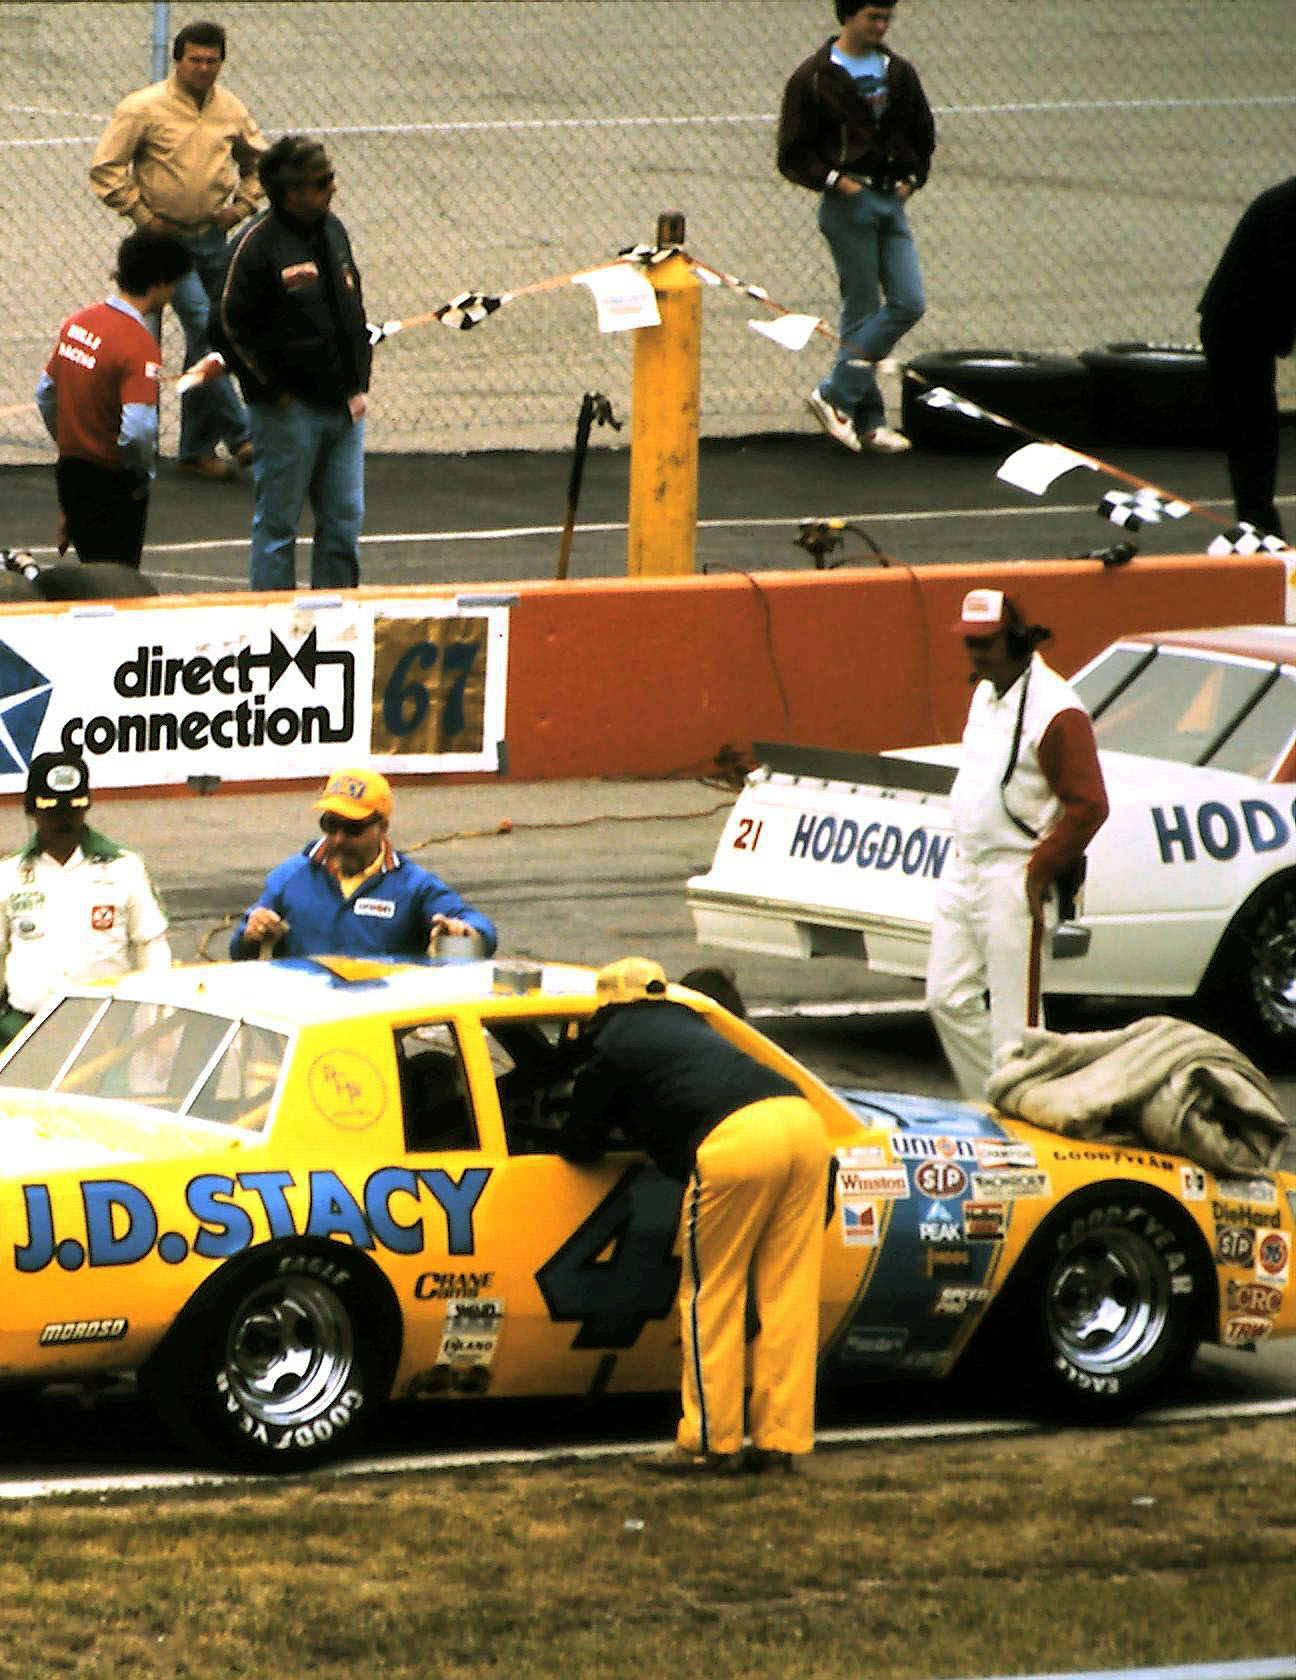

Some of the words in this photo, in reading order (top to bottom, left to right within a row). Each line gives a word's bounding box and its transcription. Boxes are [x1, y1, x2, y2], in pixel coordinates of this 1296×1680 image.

[114, 645, 255, 698] direct
[382, 641, 481, 738] 67
[61, 697, 332, 755] connection
[732, 818, 764, 852] 21
[789, 813, 954, 879] HODGDON
[1151, 799, 1296, 864] HOD
[840, 1173, 906, 1190] Winston
[920, 1163, 961, 1191] STP
[919, 1222, 961, 1240] PEAK
[1221, 1232, 1251, 1257] STP
[39, 1318, 128, 1345] MOROSO
[1228, 1321, 1268, 1339] TRW
